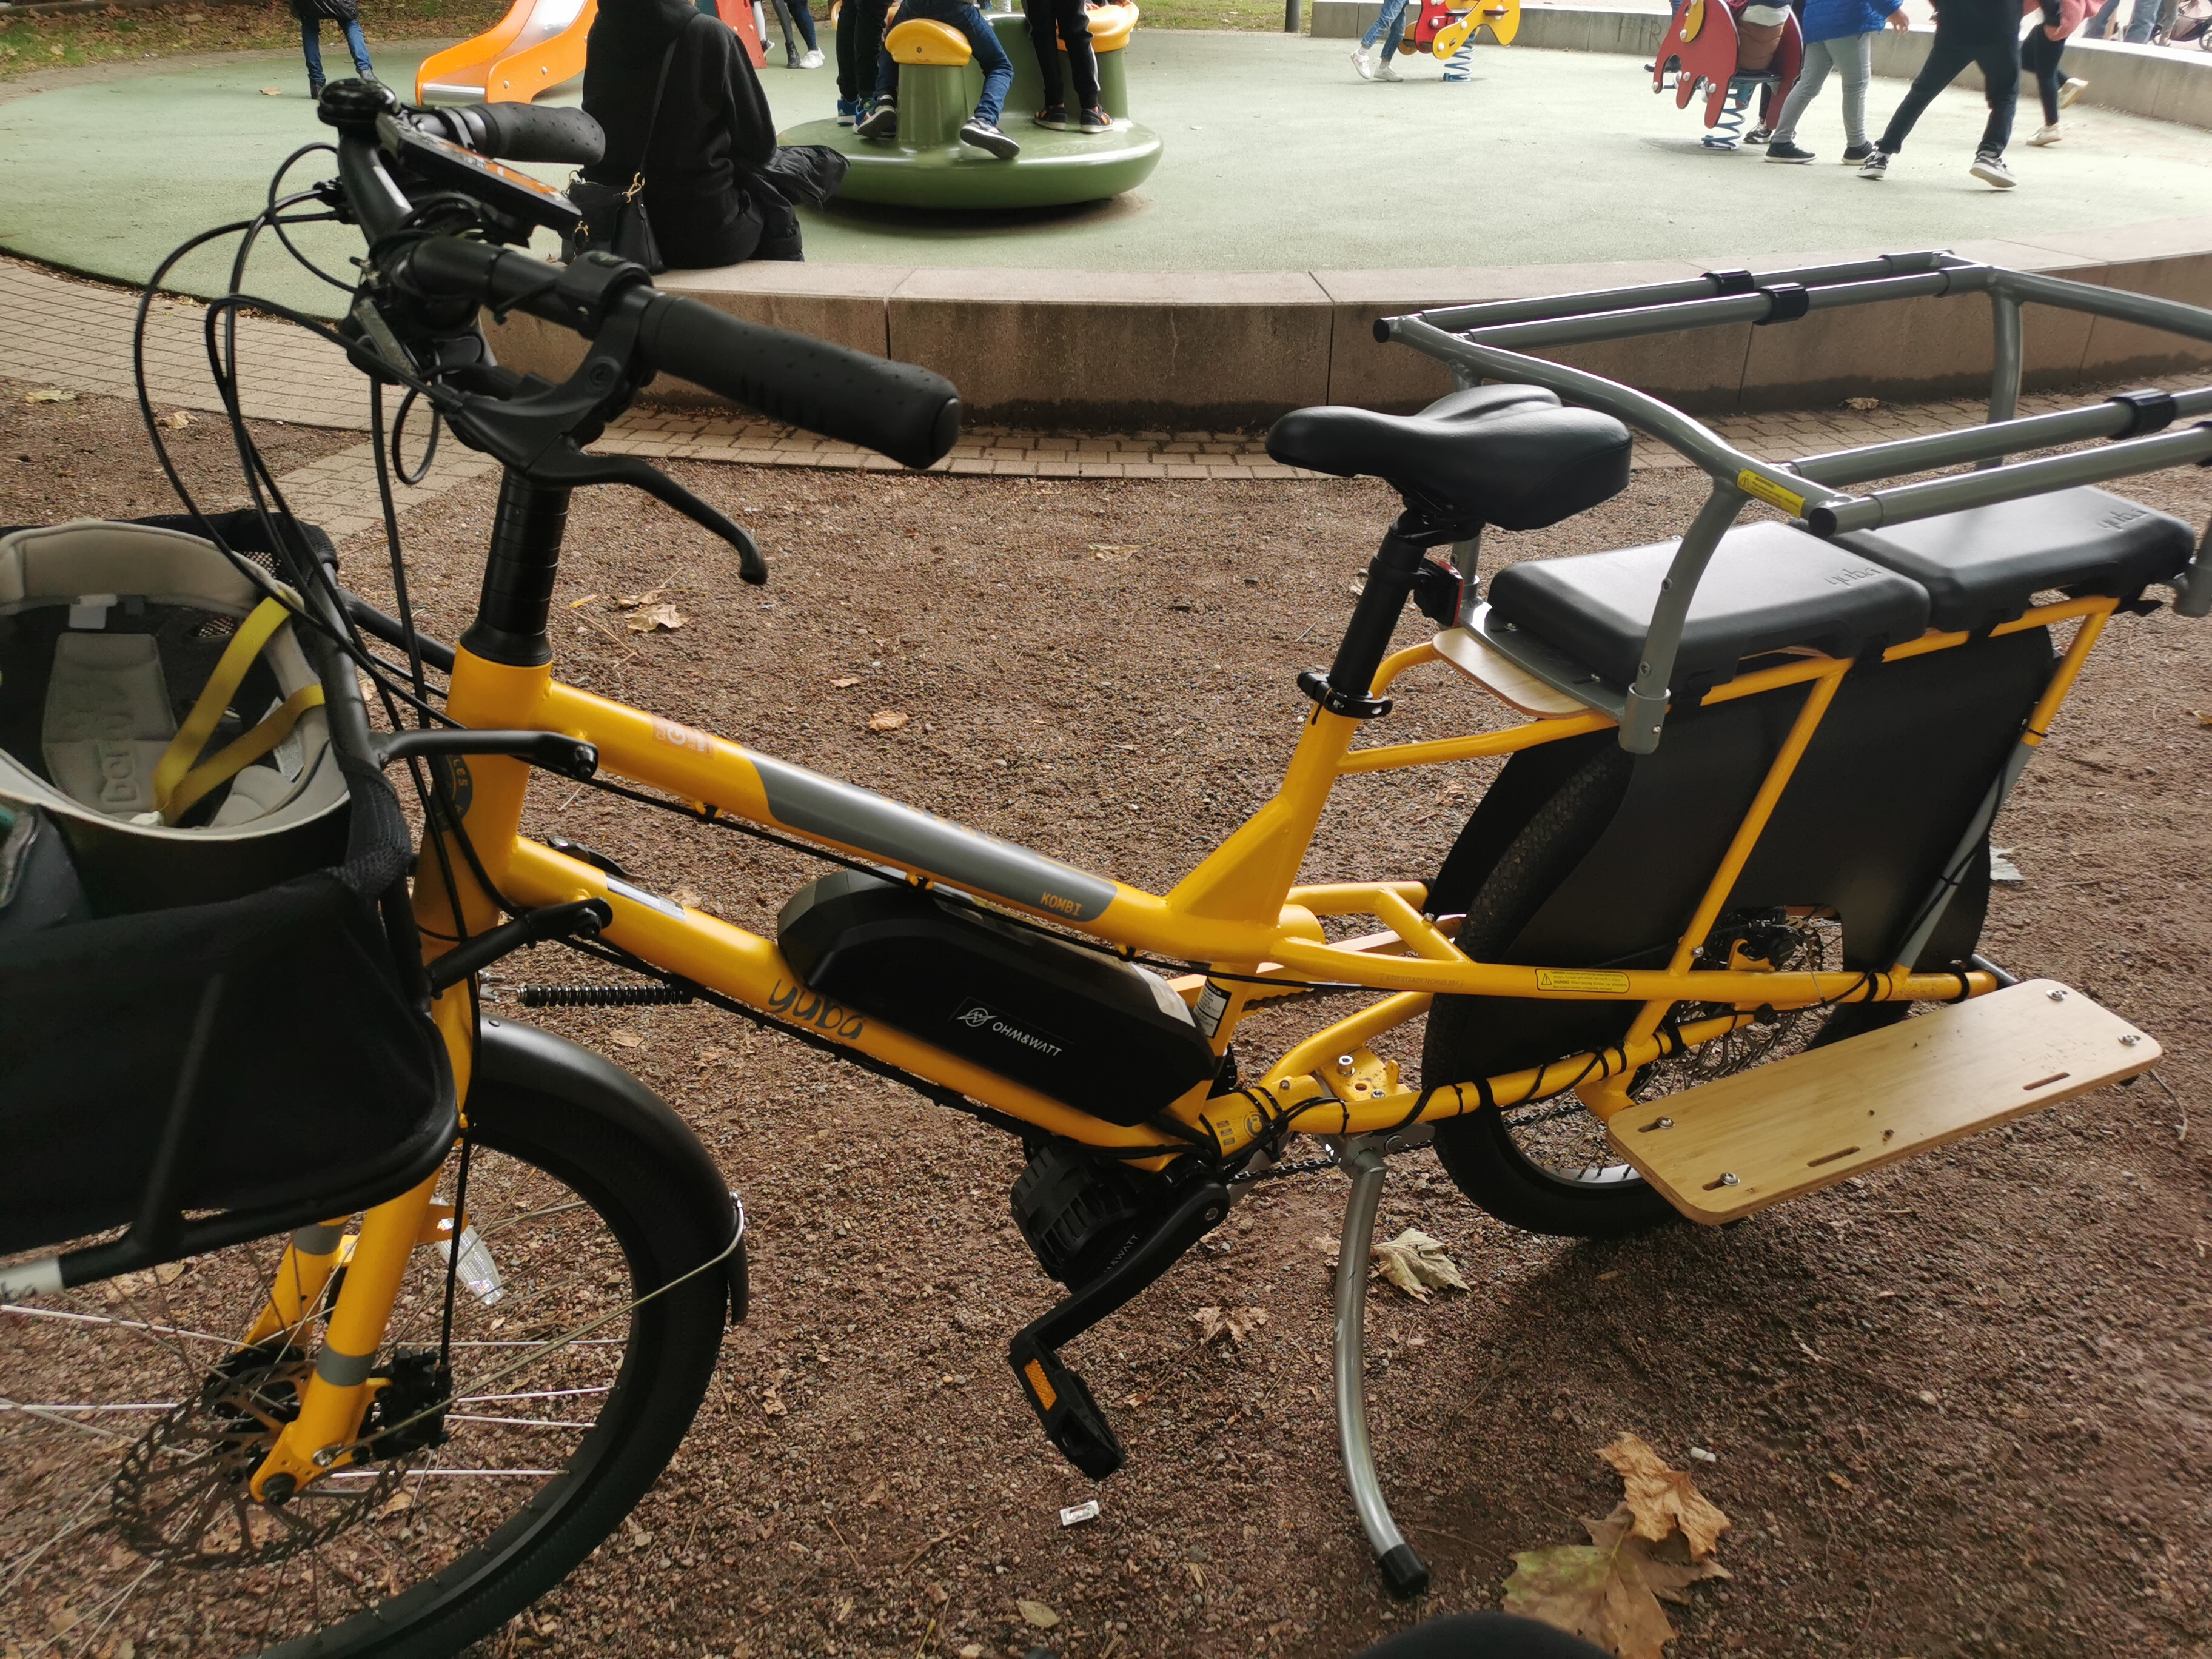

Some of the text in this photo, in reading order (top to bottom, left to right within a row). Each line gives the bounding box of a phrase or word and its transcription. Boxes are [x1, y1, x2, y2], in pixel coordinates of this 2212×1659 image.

[1824, 568, 1883, 587] yuba
[1040, 892, 1082, 917] KOMBI
[768, 979, 863, 1041] yuba
[992, 1021, 1062, 1057] OHM&WATT
[1104, 1234, 1138, 1273] &WATT
